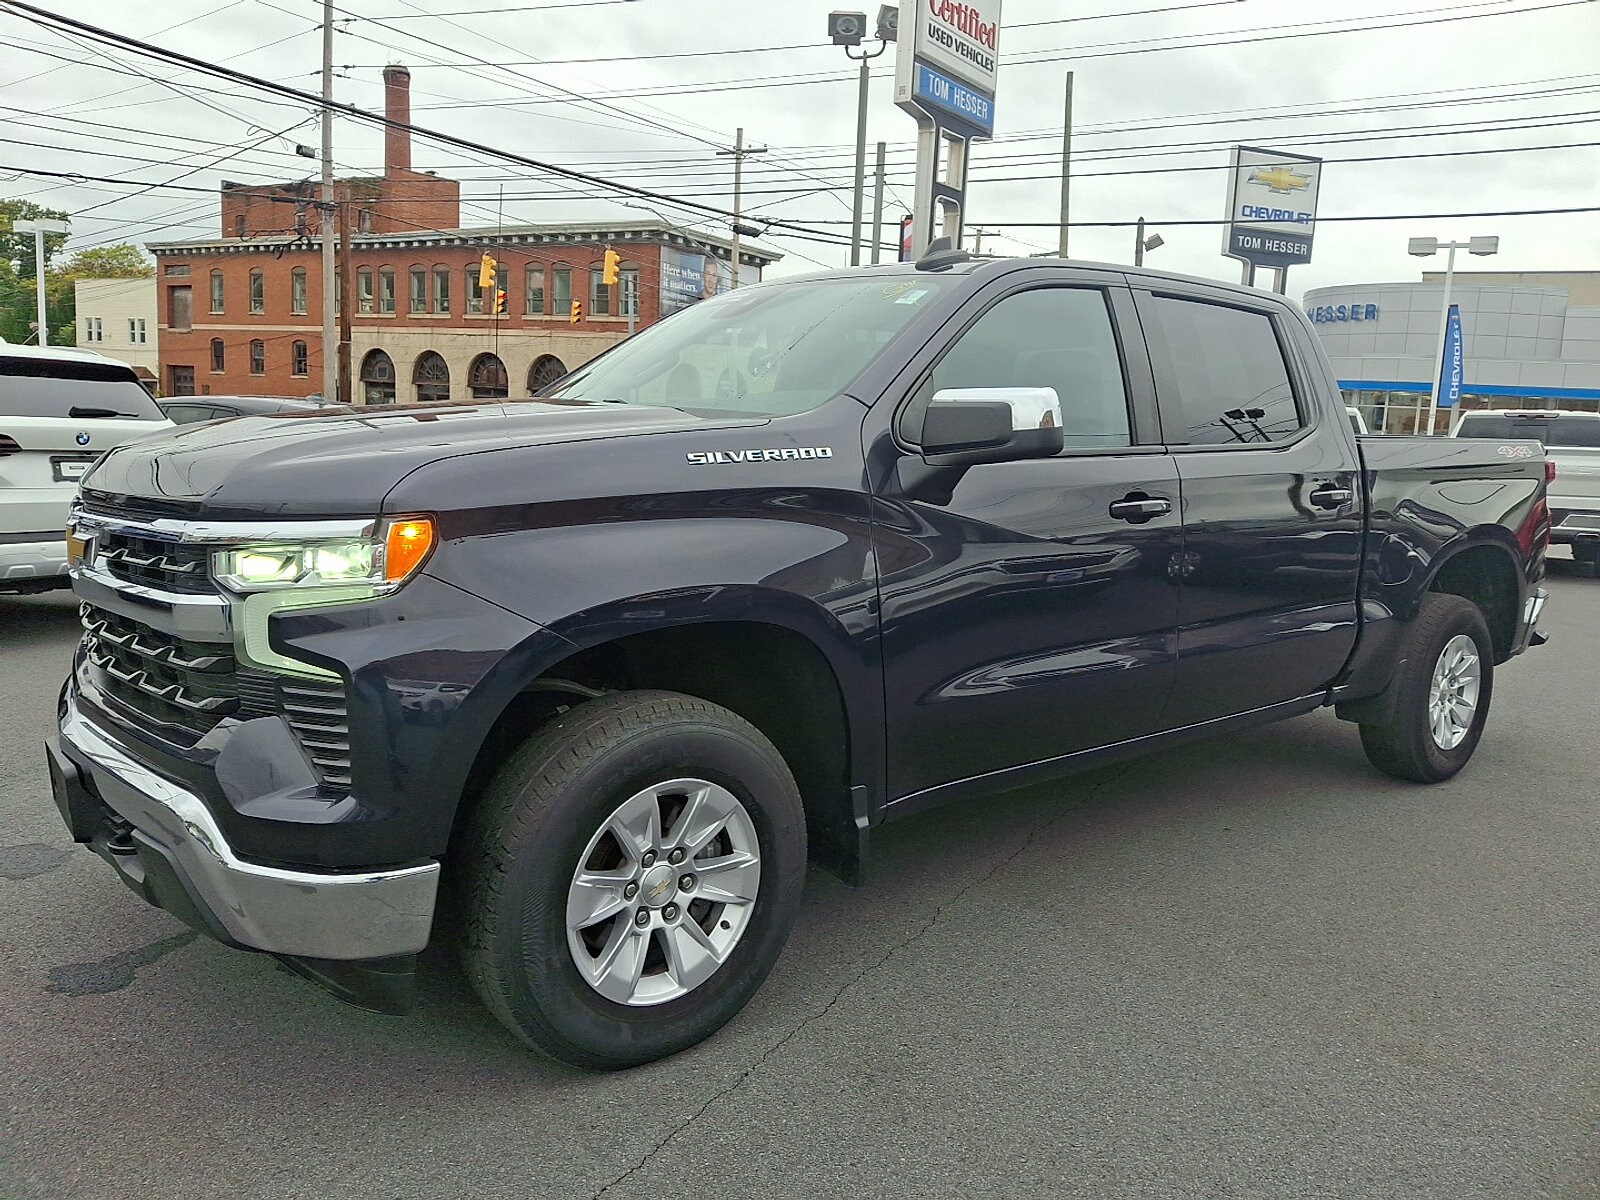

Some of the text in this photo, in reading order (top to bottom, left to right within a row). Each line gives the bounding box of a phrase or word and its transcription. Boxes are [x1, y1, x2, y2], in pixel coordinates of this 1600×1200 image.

[929, 0, 997, 51] Certified
[928, 22, 994, 72] USED VEHICLES
[928, 73, 988, 120] TOM HESSER
[1241, 204, 1312, 225] CHEVROLET
[1238, 235, 1308, 256] TOM HESSER
[663, 263, 701, 280] Here when
[1449, 322, 1461, 400] CHEVROLET
[686, 446, 833, 465] SILVERADO
